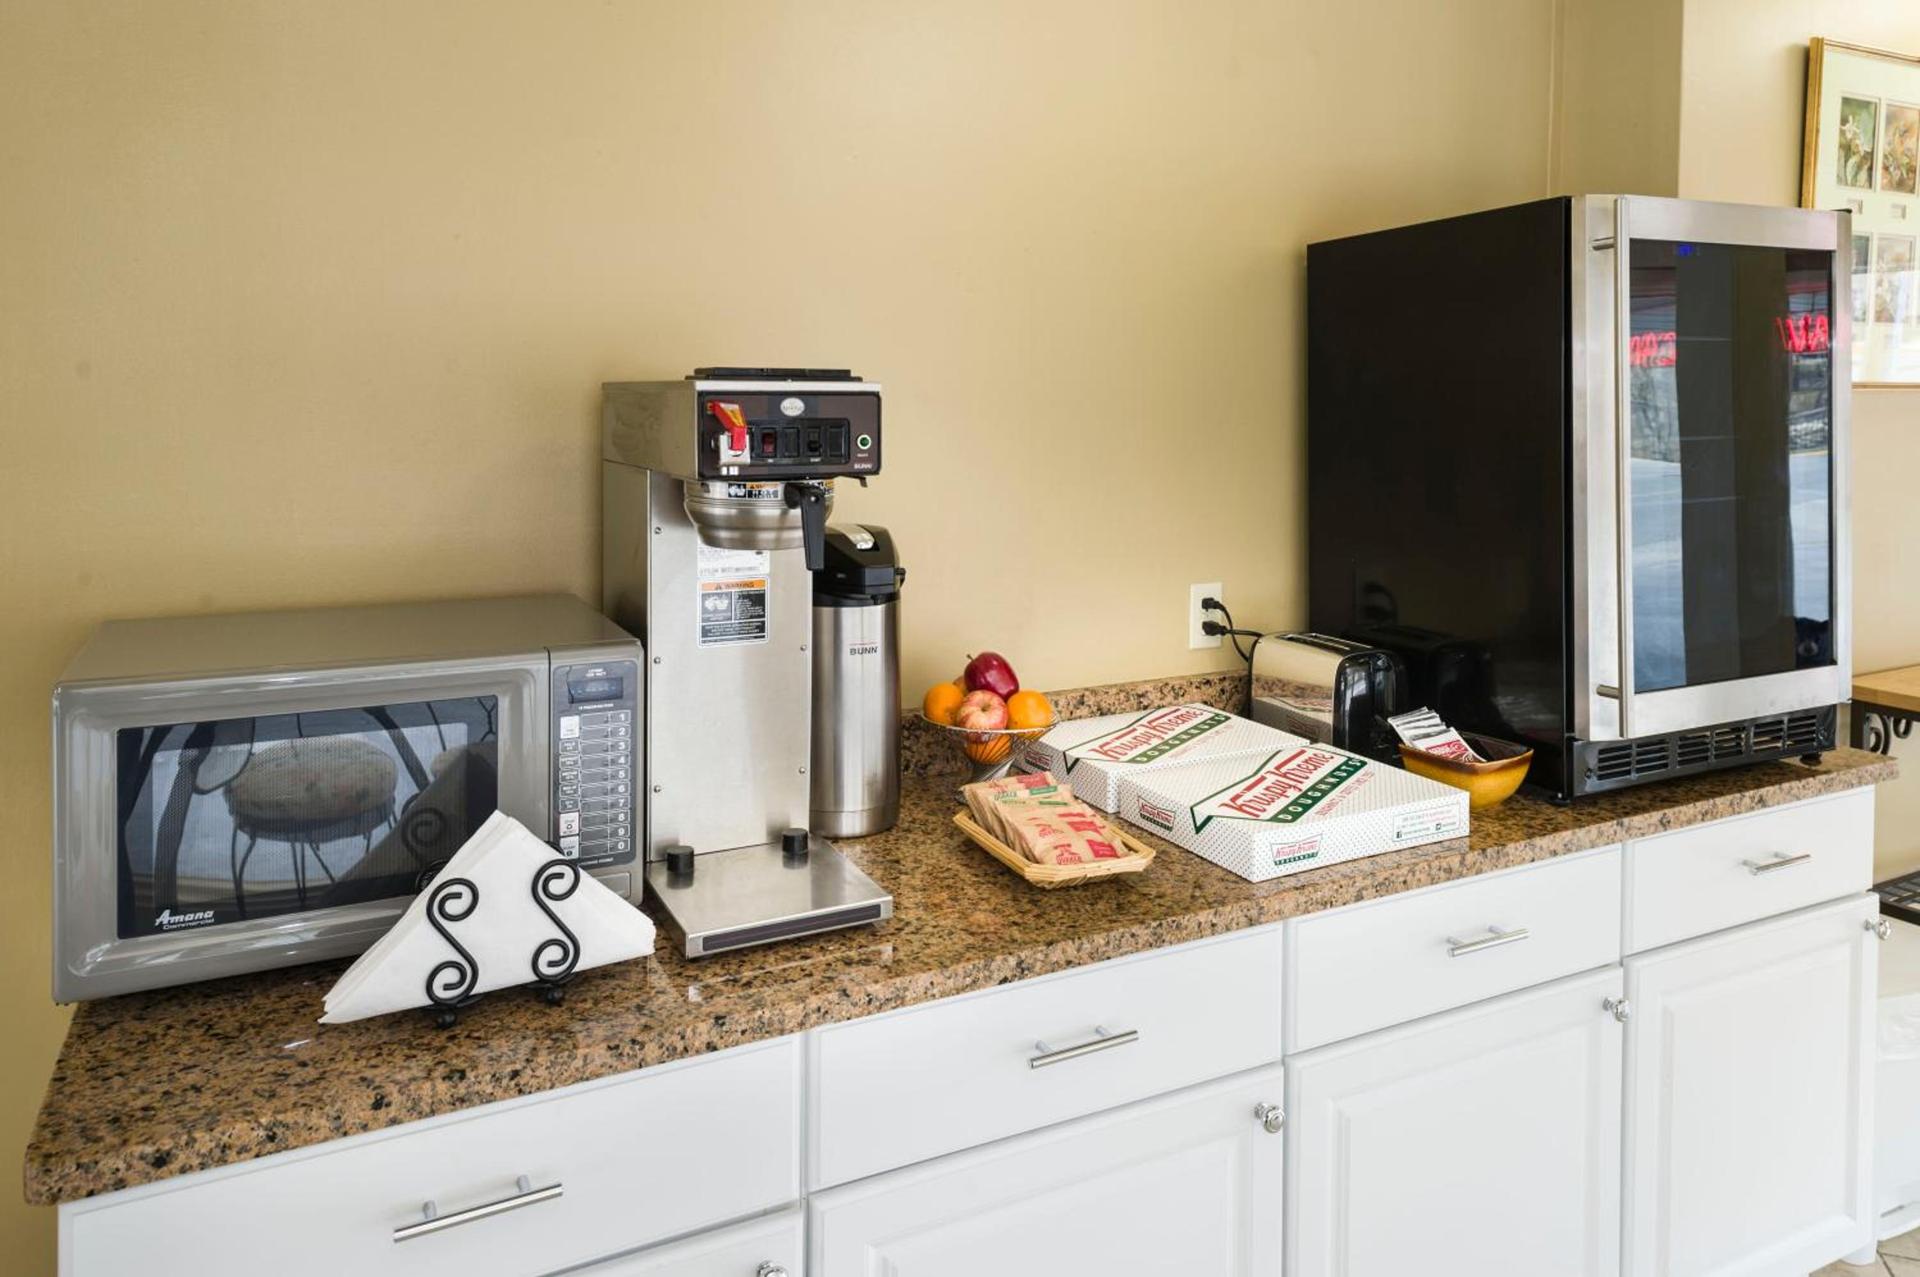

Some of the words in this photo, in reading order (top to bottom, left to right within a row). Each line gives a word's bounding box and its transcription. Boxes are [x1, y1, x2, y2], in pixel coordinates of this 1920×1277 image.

[849, 646, 879, 656] BUNN
[619, 713, 625, 722] 1
[618, 727, 626, 736] 2
[1088, 728, 1165, 760] Krispy
[1137, 708, 1205, 735] Kreme
[618, 742, 626, 750] 3
[618, 756, 626, 764] 4
[618, 770, 626, 778] 5
[1218, 774, 1302, 818] Krispy
[1264, 749, 1335, 785] Kreme
[1277, 756, 1363, 820] DOUGHNUTS
[618, 785, 626, 793] 6
[618, 799, 625, 807] 7
[618, 813, 625, 821] 8
[618, 827, 625, 836] 9
[618, 841, 625, 850] 0
[154, 909, 215, 926] Amana
